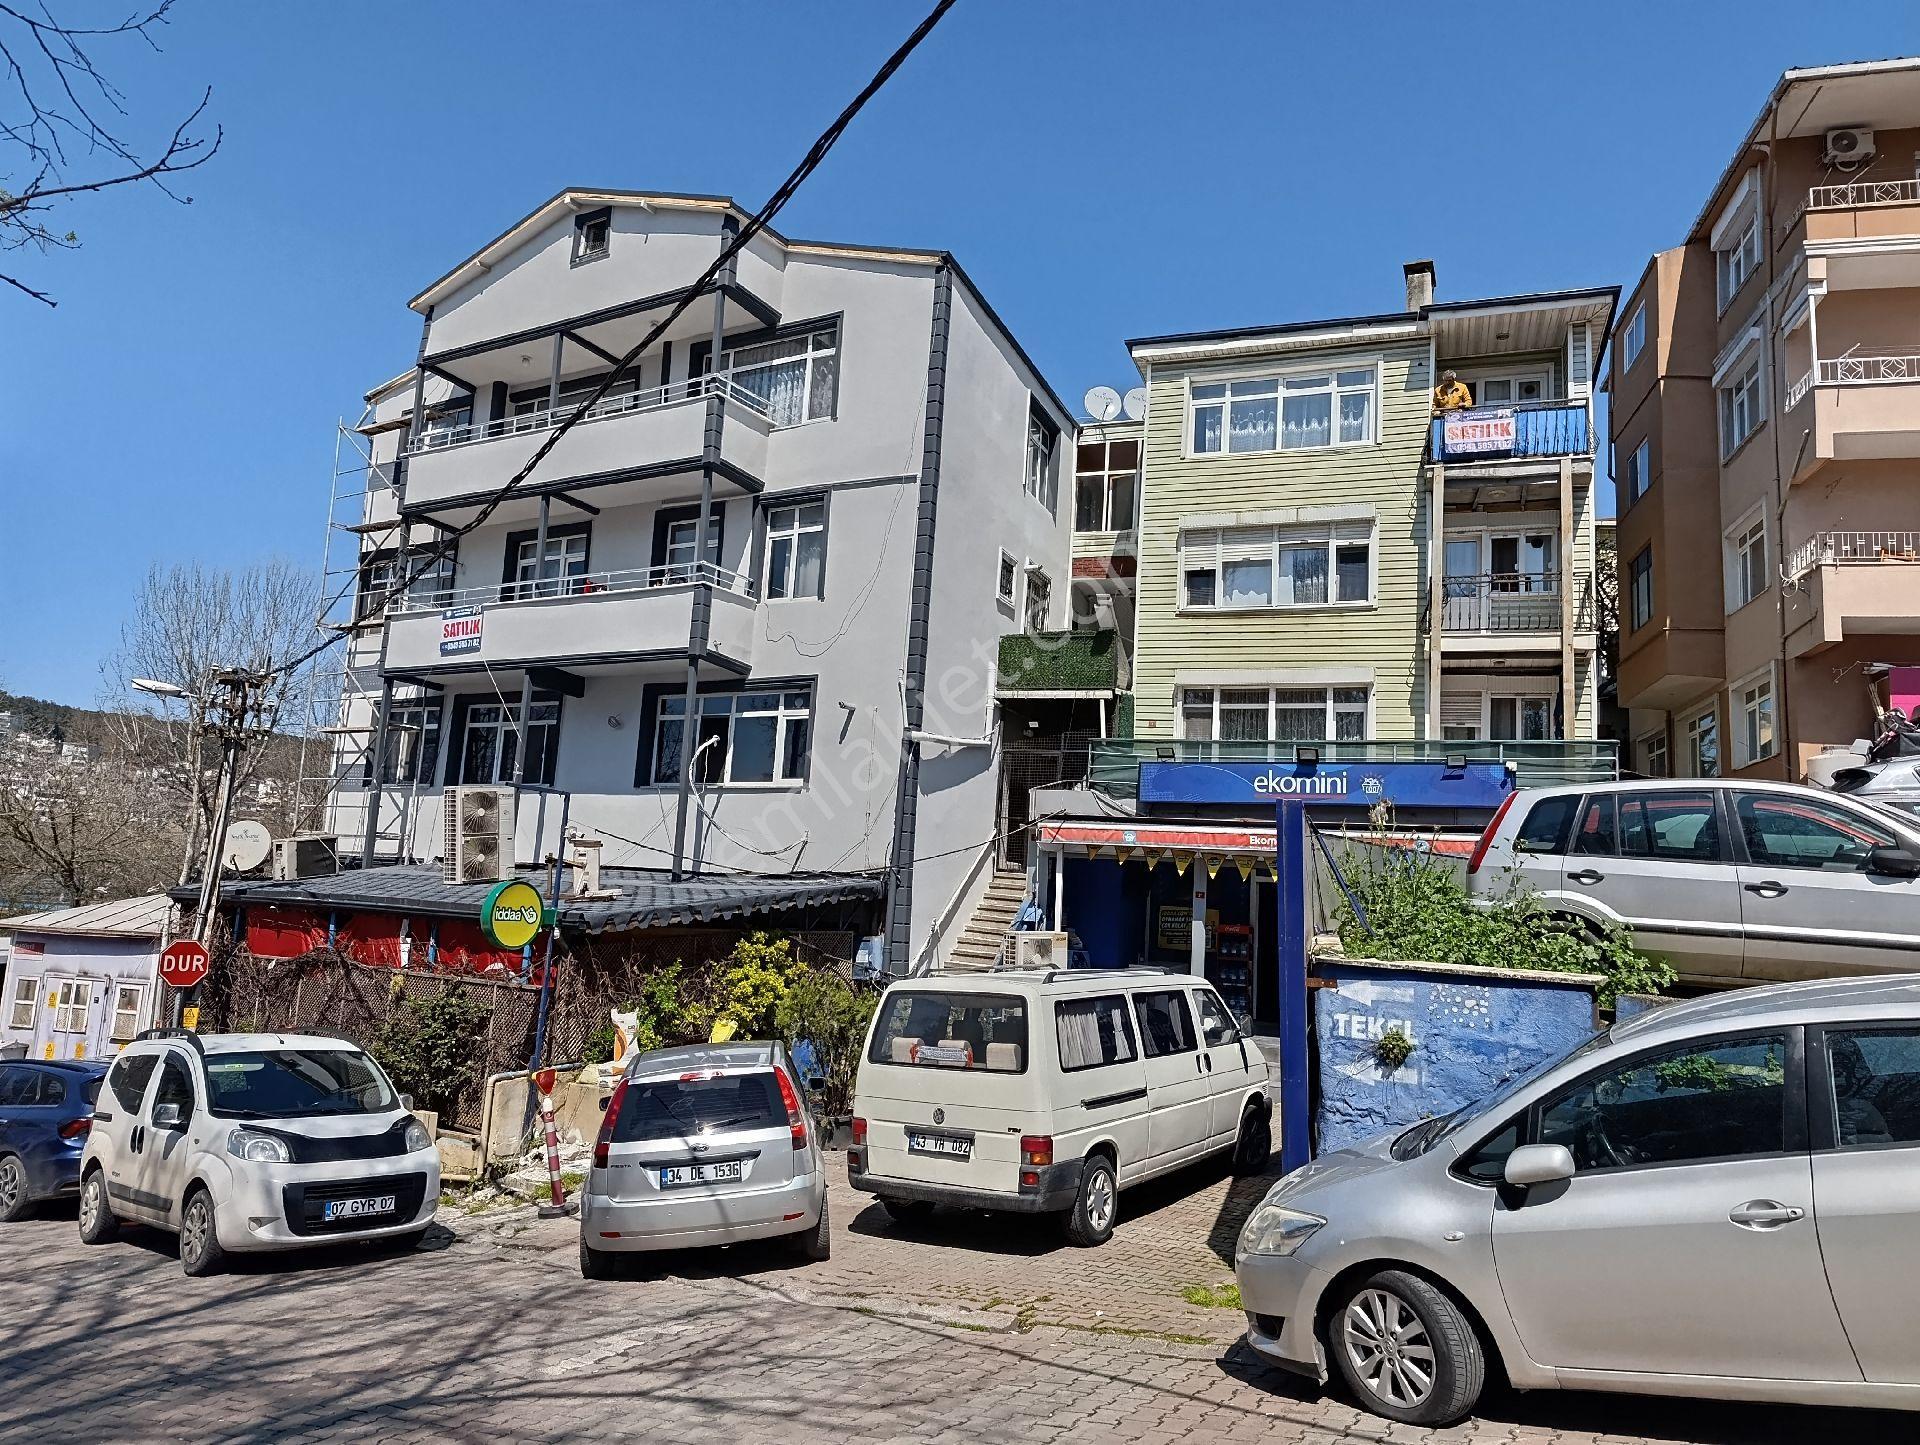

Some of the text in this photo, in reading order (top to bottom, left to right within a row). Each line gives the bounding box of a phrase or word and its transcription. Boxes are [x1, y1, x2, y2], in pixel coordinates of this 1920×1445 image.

[1448, 422, 1512, 440] SATILIK
[443, 619, 481, 638] SATILIK
[1253, 769, 1347, 794] ekomini
[495, 906, 521, 921] iddaa
[162, 954, 205, 972] DUR
[915, 1134, 969, 1153] 43 VH 082
[668, 1169, 682, 1183] 34
[690, 1166, 705, 1180] DE
[713, 1162, 740, 1178] 1536
[331, 1201, 346, 1215] 07
[350, 1198, 377, 1213] GYR
[380, 1196, 394, 1209] 07
